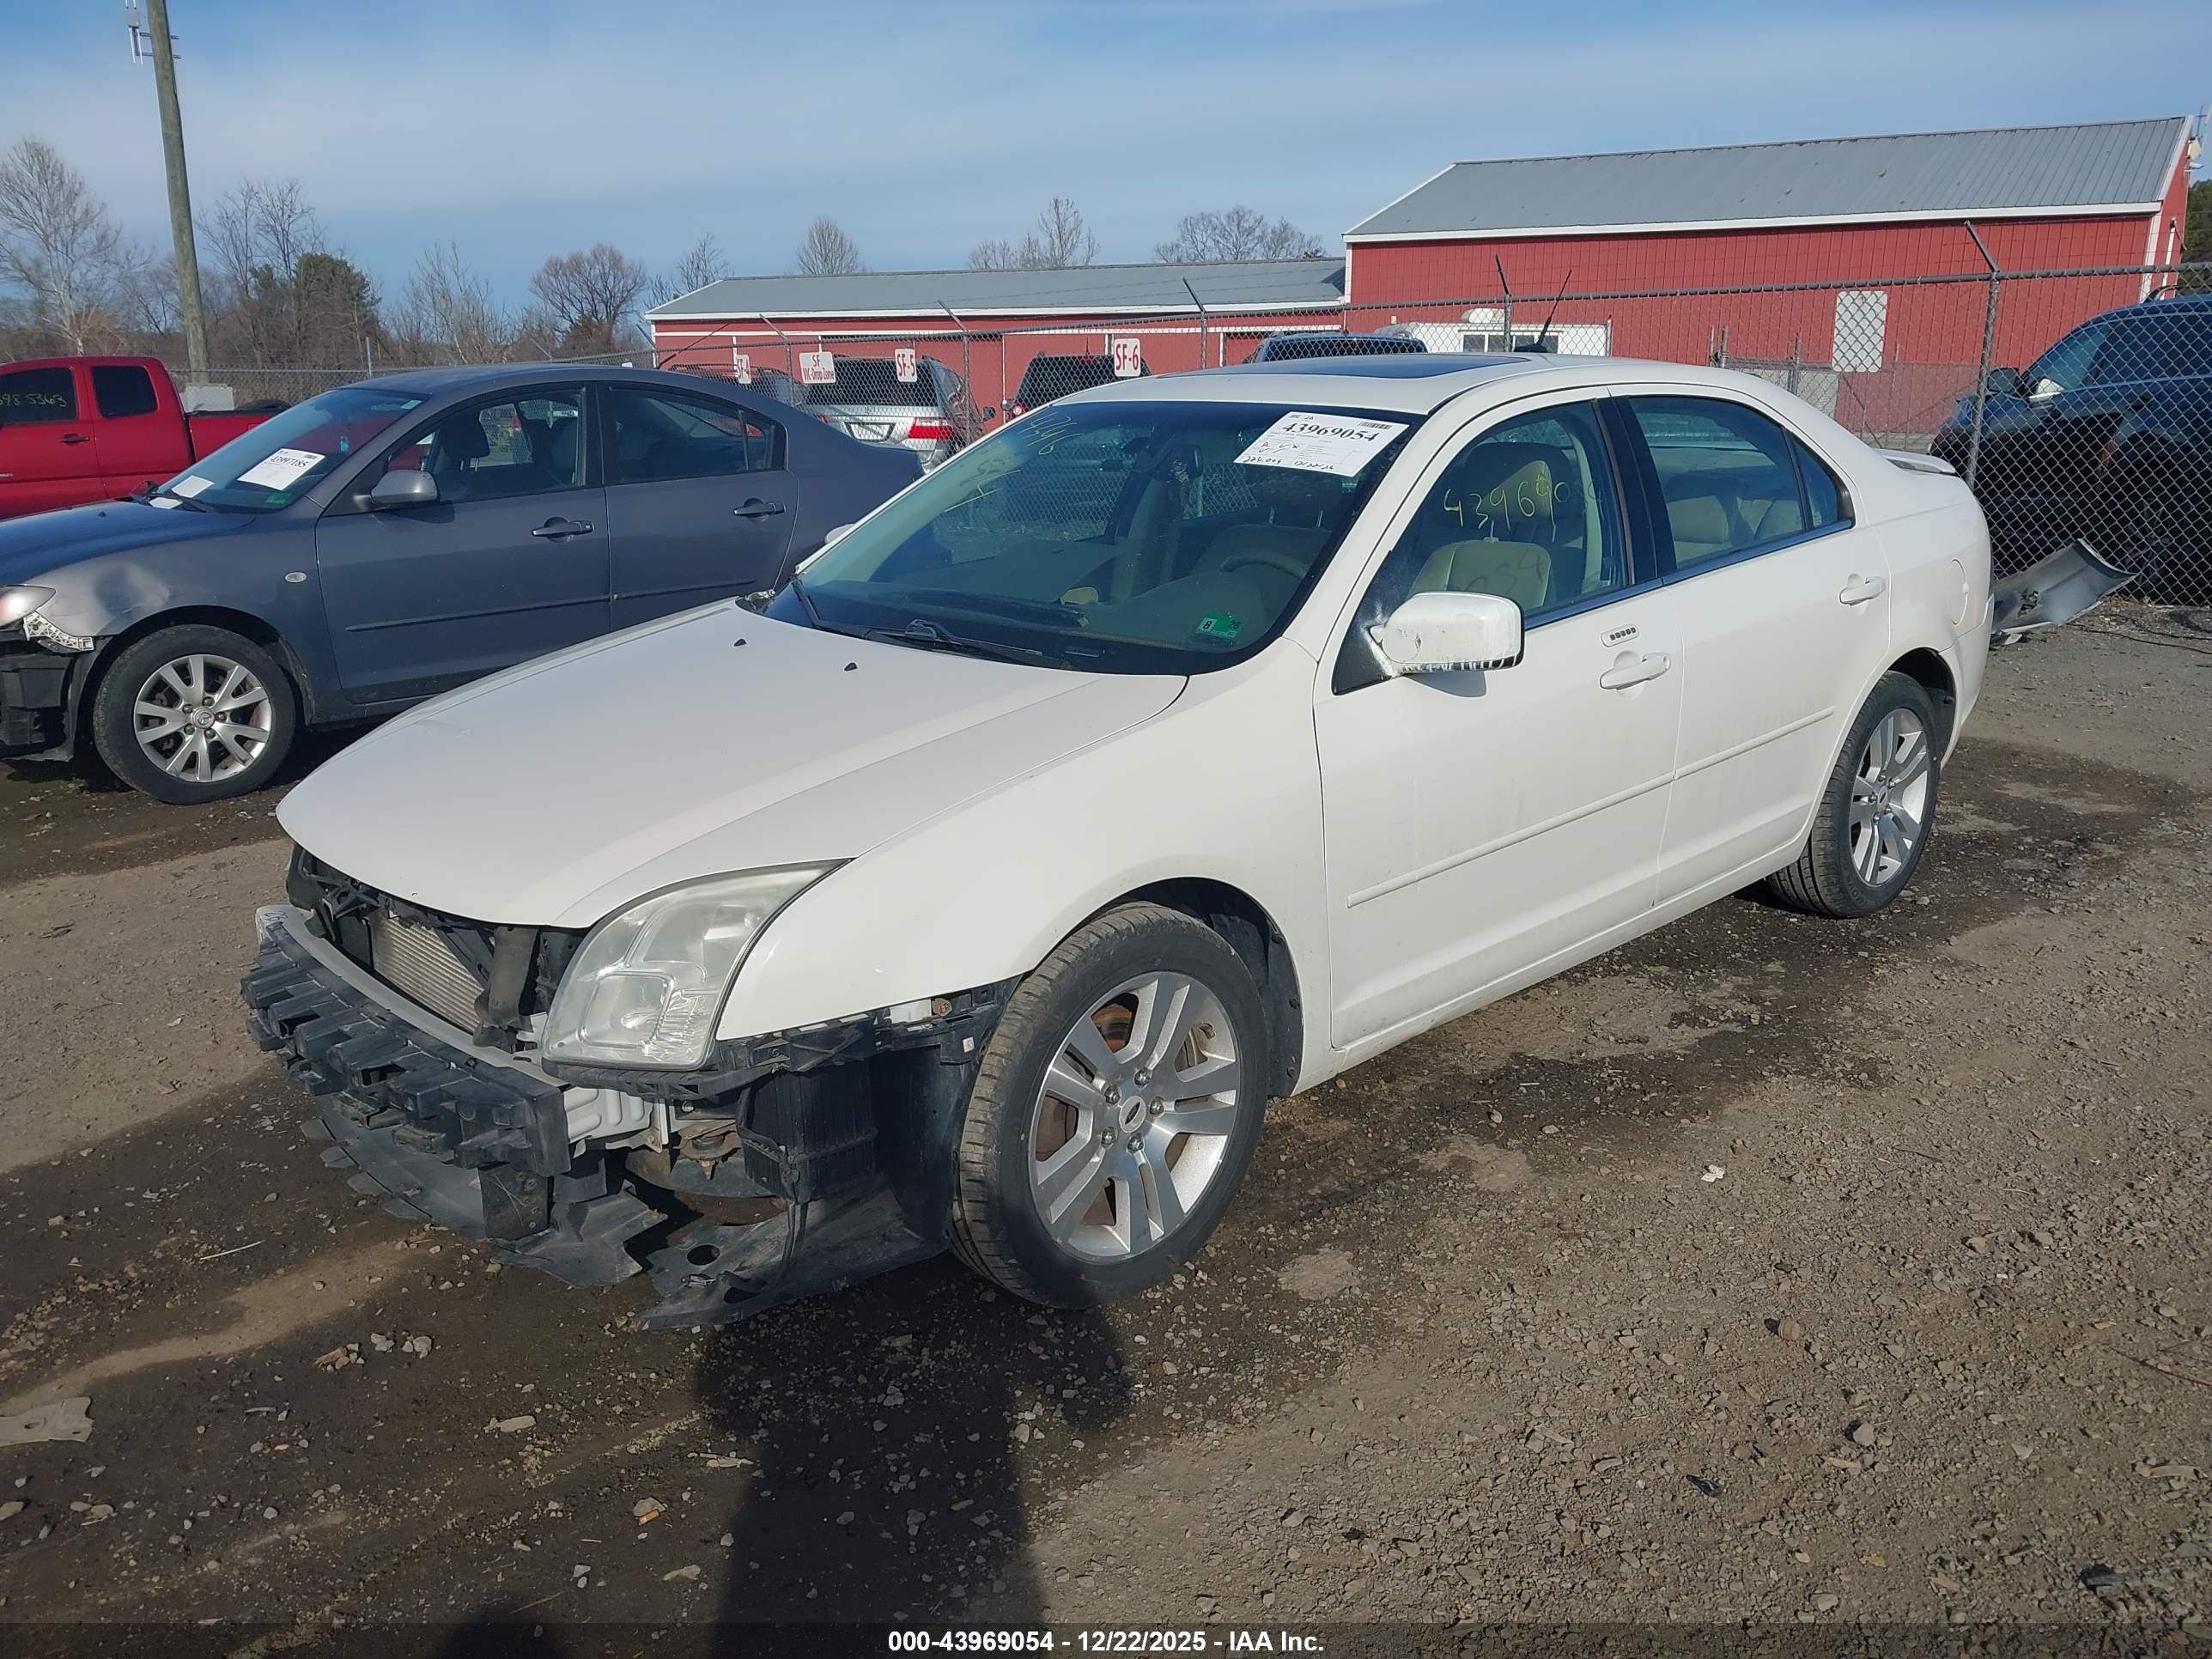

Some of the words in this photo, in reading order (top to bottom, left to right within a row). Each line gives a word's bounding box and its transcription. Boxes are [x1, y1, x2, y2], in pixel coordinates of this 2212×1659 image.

[811, 354, 821, 368] SF
[896, 353, 915, 377] SF-5
[1116, 343, 1139, 370] SF-6
[1282, 422, 1381, 442] 43969054
[1202, 620, 1212, 629] 8
